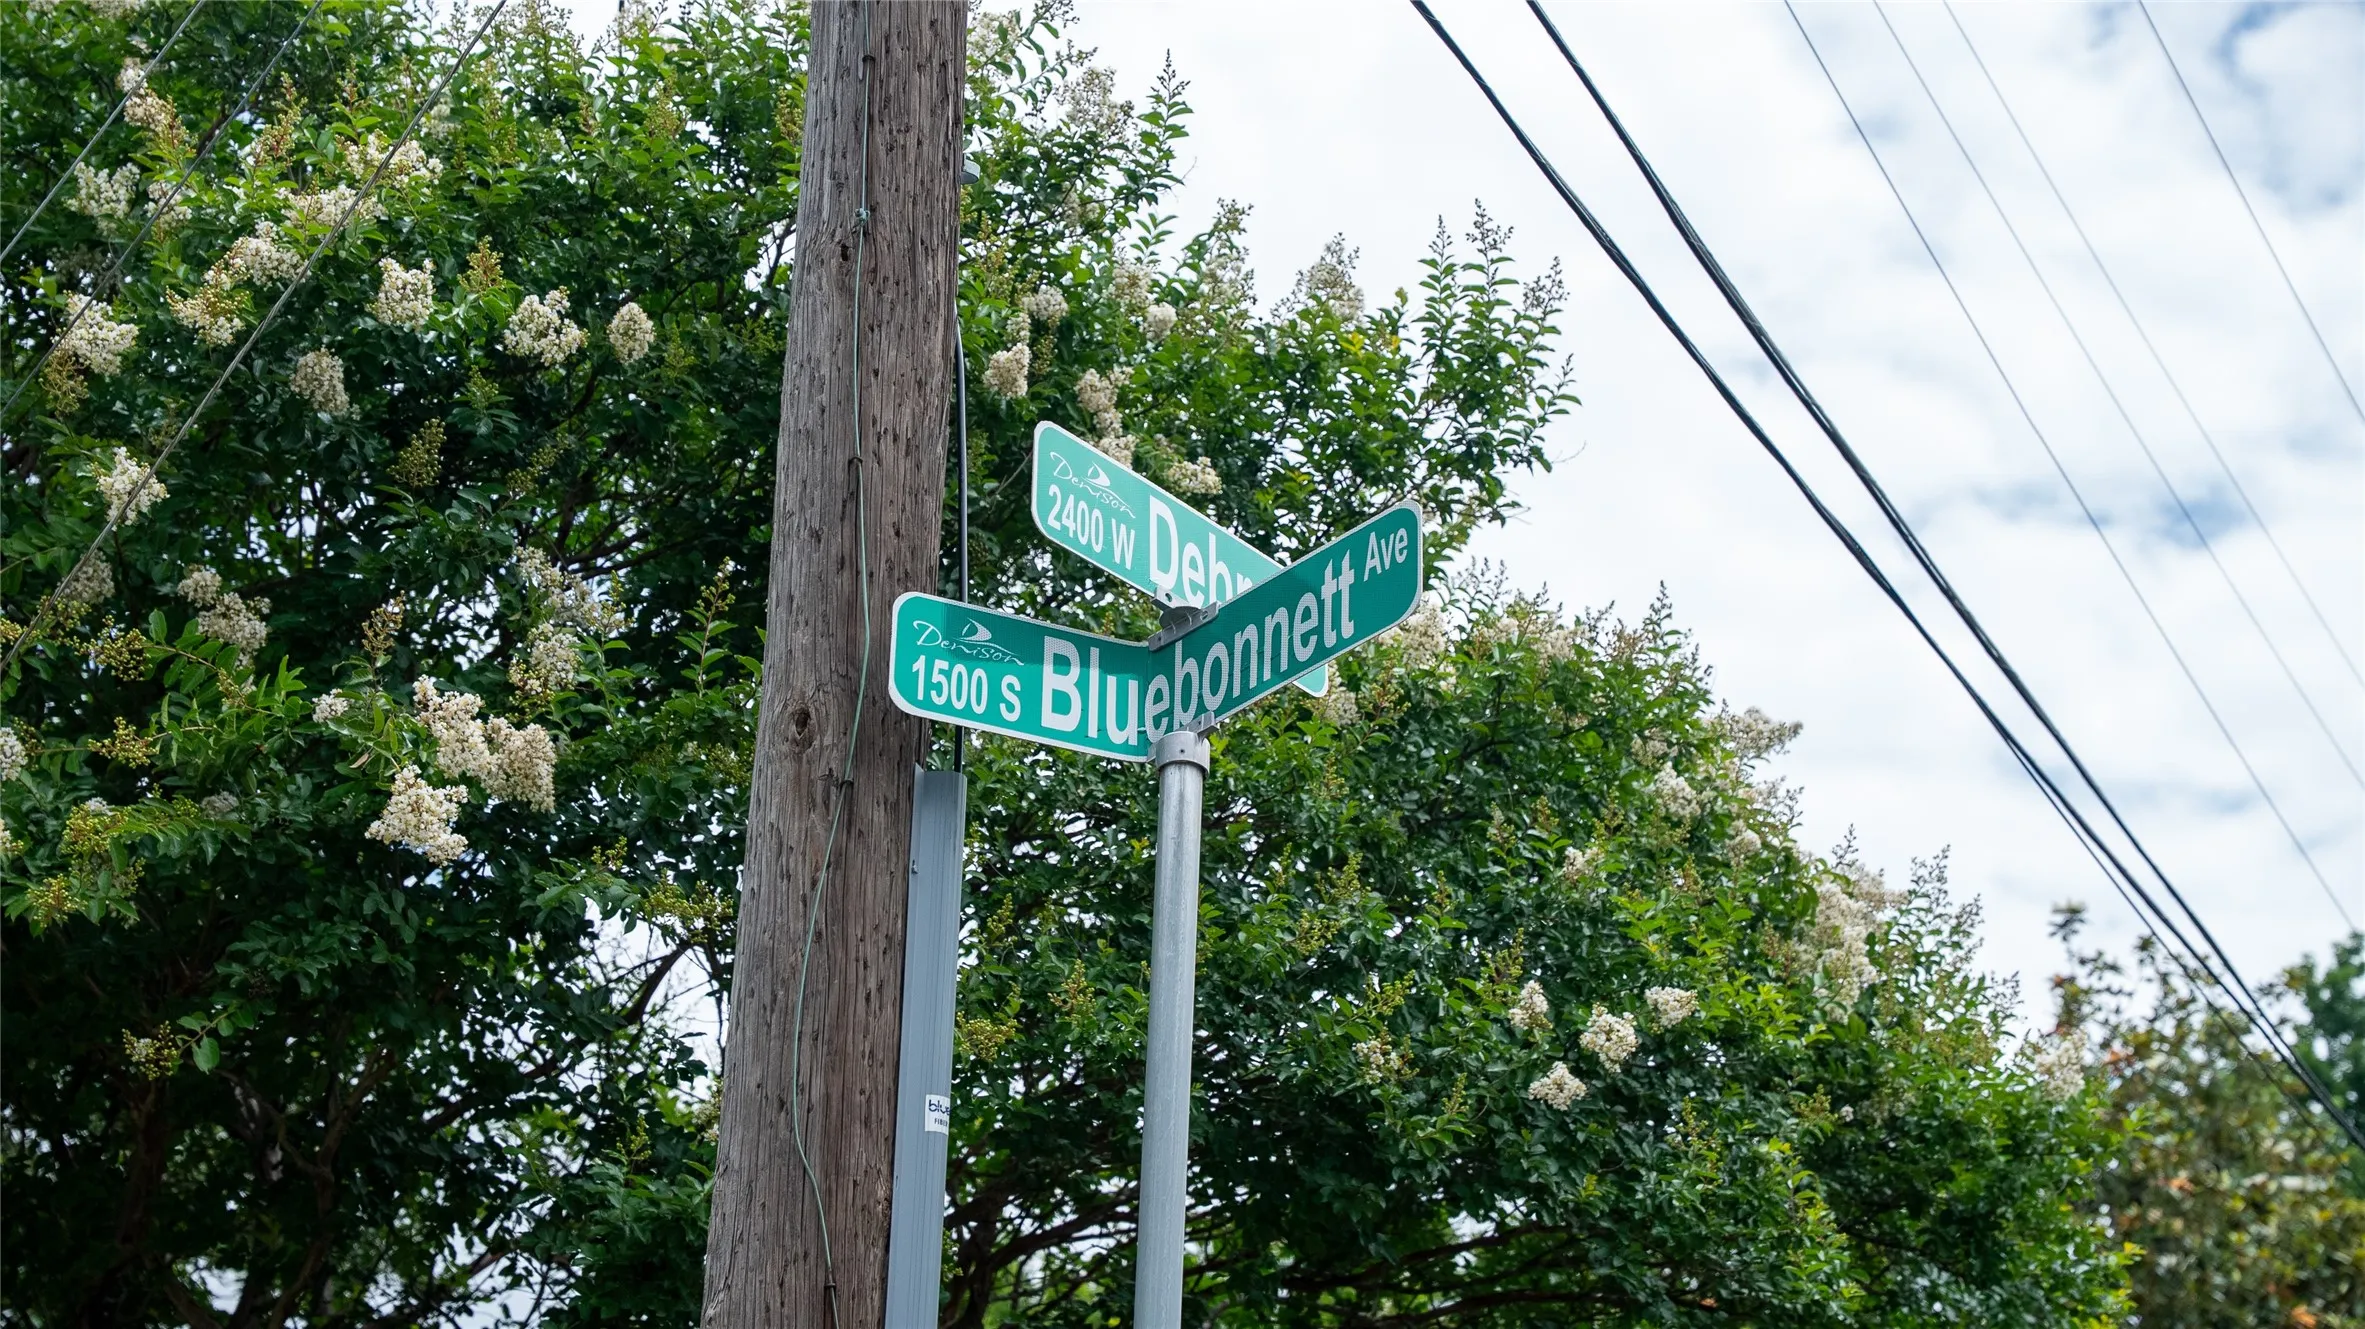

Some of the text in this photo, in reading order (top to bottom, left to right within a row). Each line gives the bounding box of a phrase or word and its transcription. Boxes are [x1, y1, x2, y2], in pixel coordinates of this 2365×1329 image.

[1050, 451, 1136, 519] Denison
[1048, 484, 1103, 553] 2400
[1112, 518, 1135, 570] W
[911, 528, 1408, 746] 1500 S Bluebonnett Ave
[913, 620, 1024, 666] Denison
